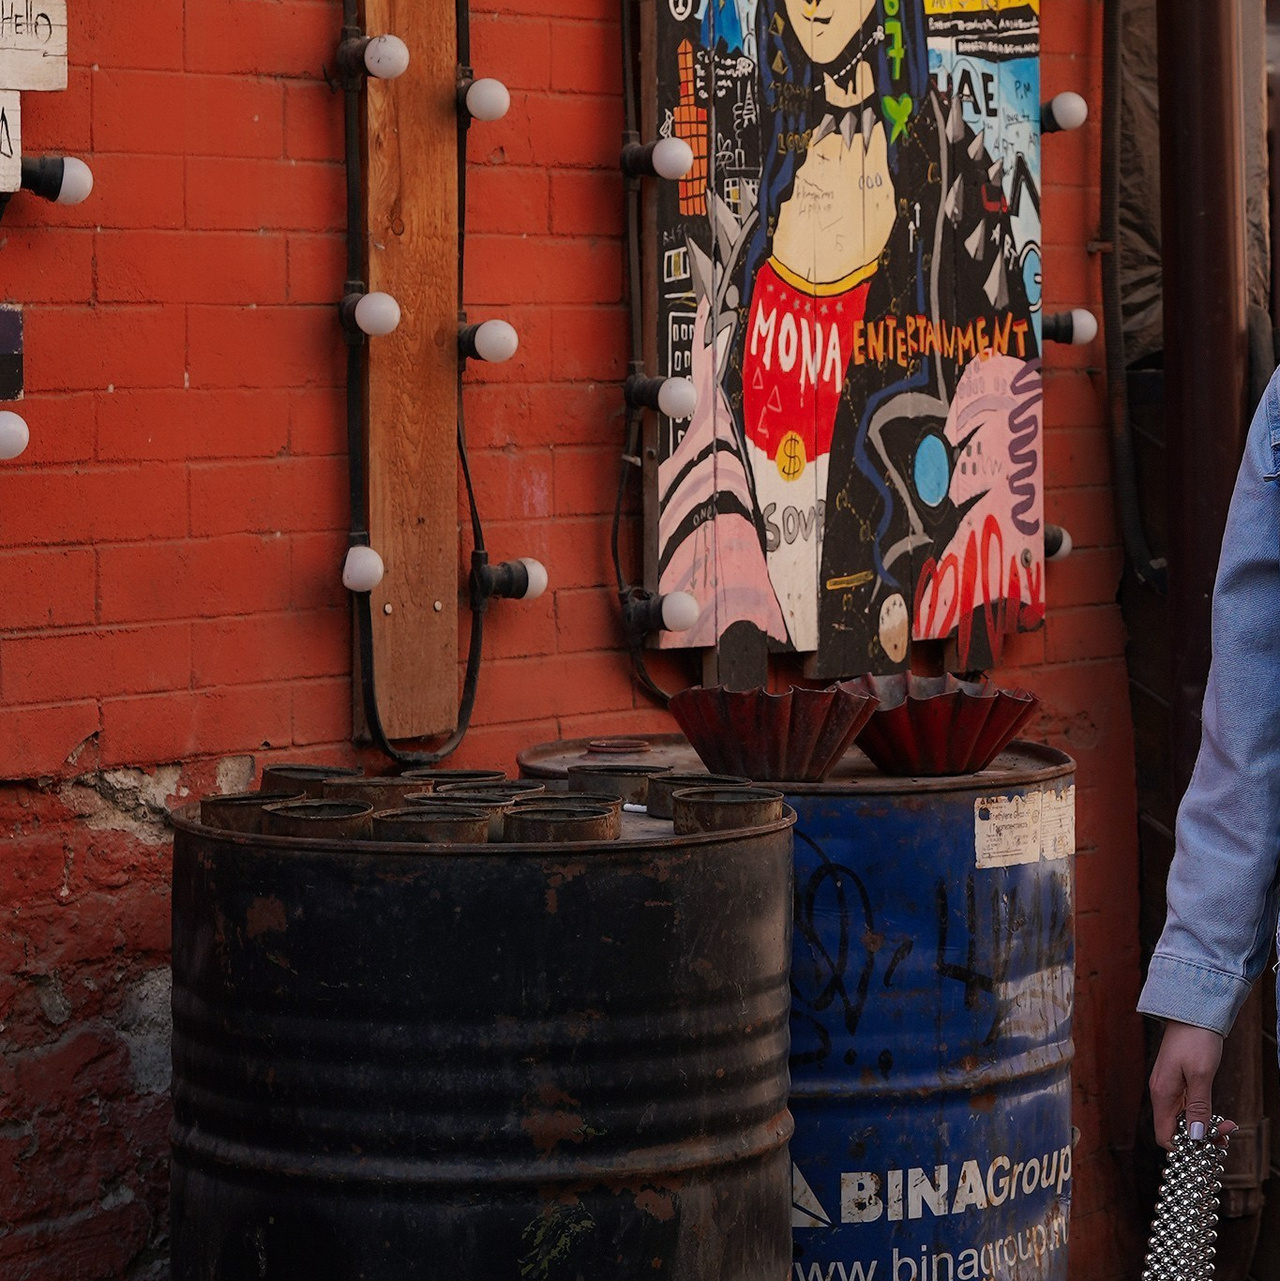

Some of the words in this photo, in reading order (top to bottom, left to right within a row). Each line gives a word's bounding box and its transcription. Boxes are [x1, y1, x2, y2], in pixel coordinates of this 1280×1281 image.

[750, 299, 842, 393] MONA
[852, 311, 1029, 368] ENTERTAINMENT
[840, 1144, 1073, 1224] BINAGroup
